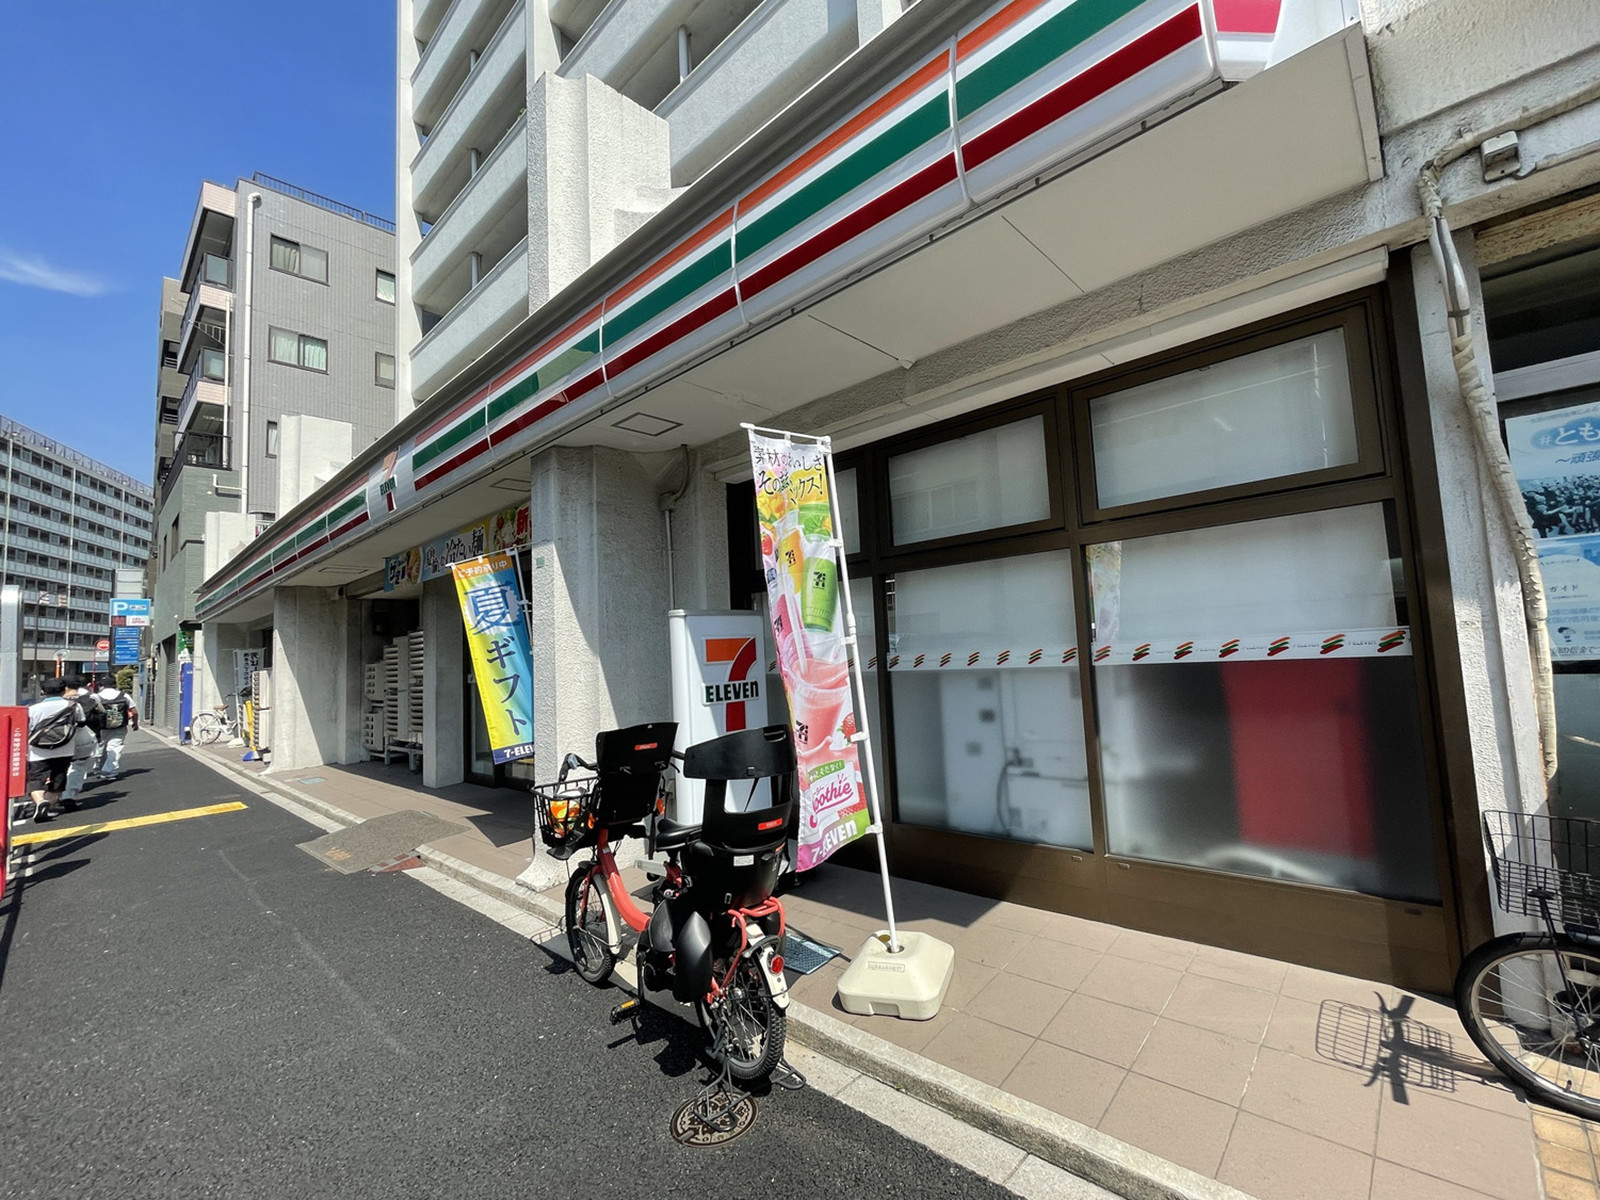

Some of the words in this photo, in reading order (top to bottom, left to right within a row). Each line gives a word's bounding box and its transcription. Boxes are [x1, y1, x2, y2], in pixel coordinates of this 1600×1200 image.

[113, 602, 128, 615] P
[464, 580, 528, 736] 夏ギフト
[503, 744, 534, 759] 7-ELE
[809, 779, 854, 828] othie
